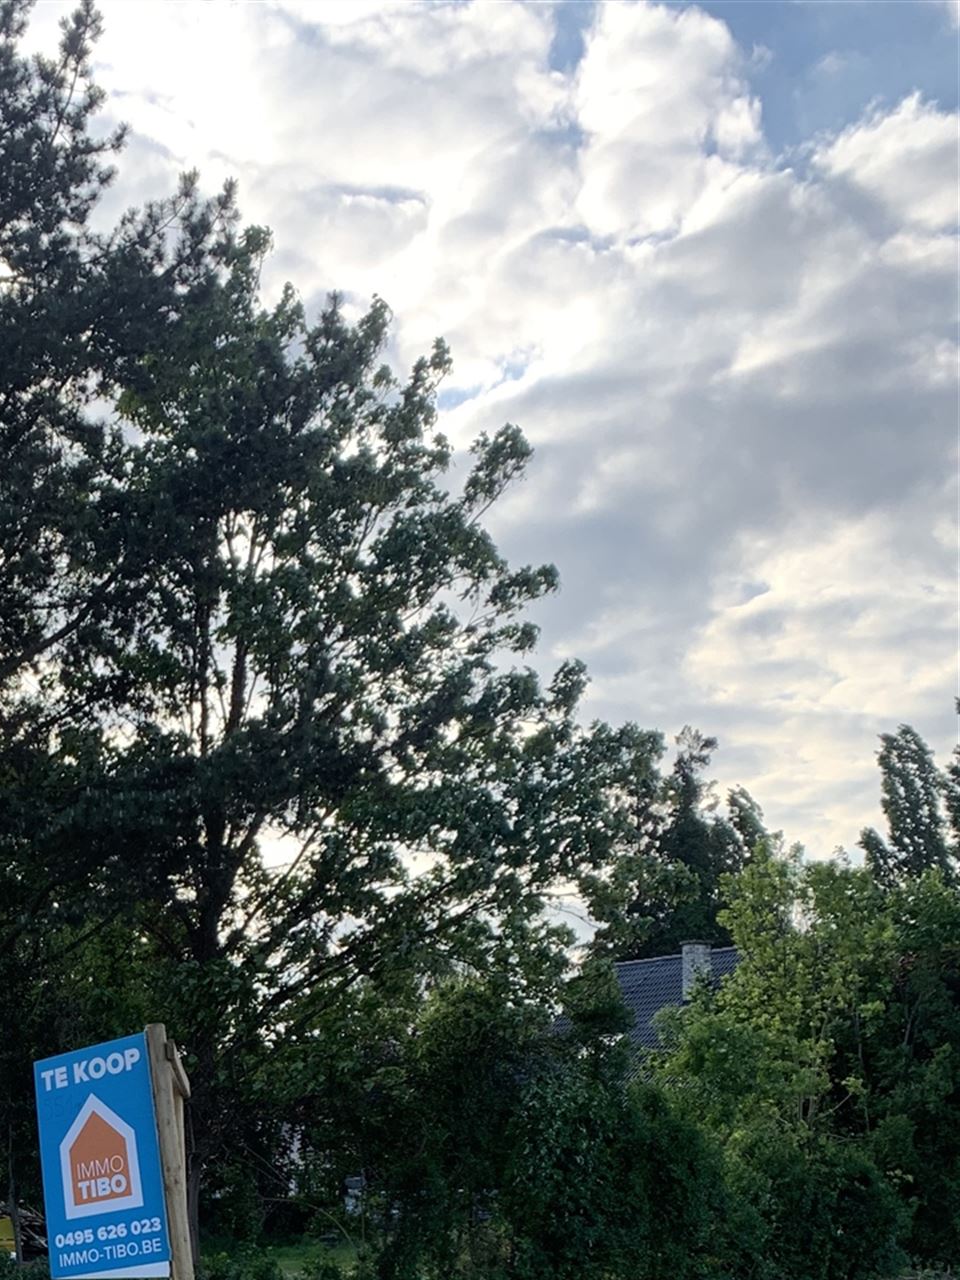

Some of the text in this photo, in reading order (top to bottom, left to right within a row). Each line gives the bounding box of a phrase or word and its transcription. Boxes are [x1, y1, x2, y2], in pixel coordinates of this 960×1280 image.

[41, 1048, 140, 1092] TE KOOP
[77, 1155, 124, 1181] IMMO
[78, 1173, 127, 1200] TIBO
[55, 1217, 162, 1248] 0495 626 023
[59, 1238, 162, 1268] IMMO-TIBO.BE
